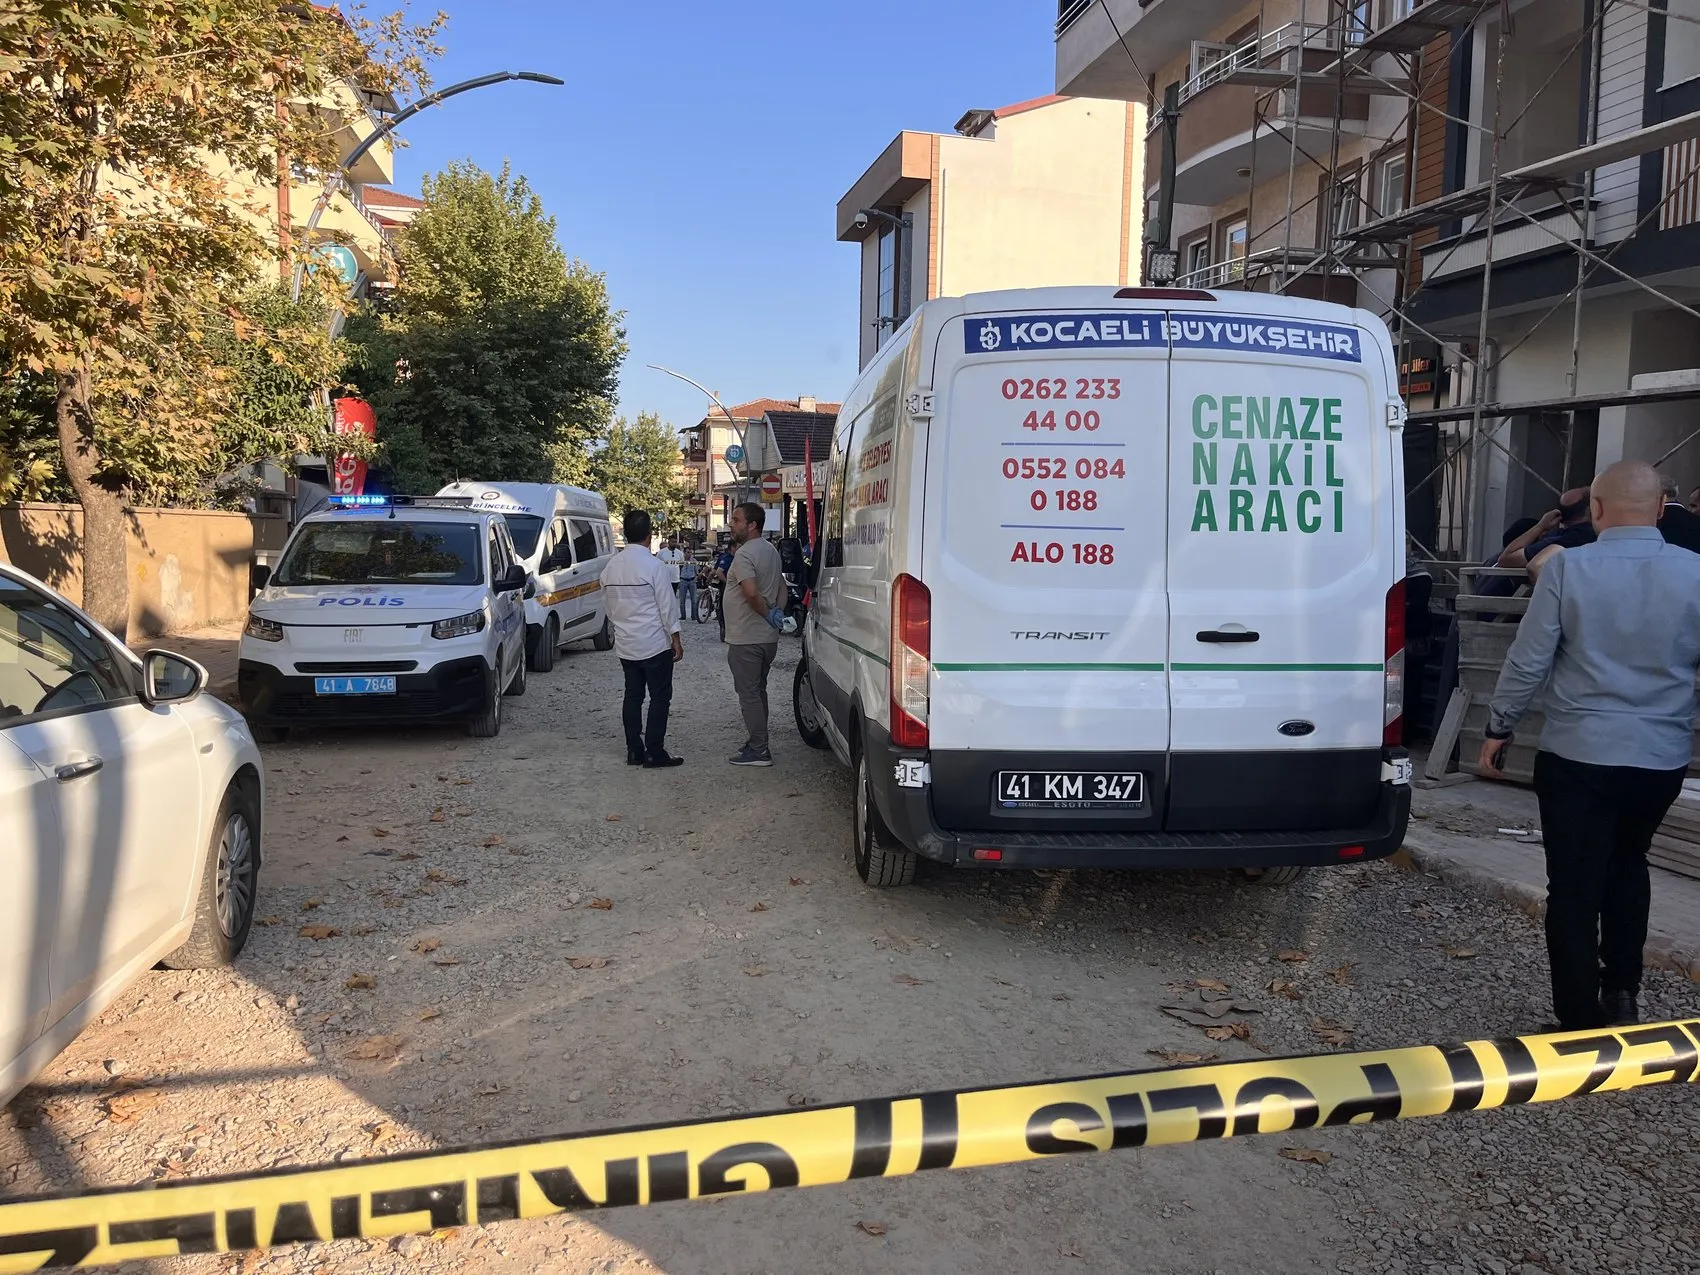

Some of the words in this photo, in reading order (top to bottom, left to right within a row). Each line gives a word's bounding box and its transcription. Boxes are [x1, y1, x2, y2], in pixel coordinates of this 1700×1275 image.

[1011, 320, 1150, 344] KOCAELİ
[1160, 320, 1354, 355] BÜYÜKŞEHİR
[1001, 378, 1067, 400] 0262
[1075, 378, 1121, 400] 233
[1022, 410, 1057, 431] 44
[1065, 410, 1100, 431] 00
[1191, 394, 1343, 441] CENAZE
[1002, 458, 1067, 479] 0552
[1075, 458, 1125, 479] 084
[1192, 442, 1344, 487] NAKİL
[1030, 489, 1047, 511] 0
[1055, 489, 1098, 511] 188
[1190, 489, 1343, 533] ARACI
[1010, 541, 1064, 563] ALO
[1072, 543, 1114, 565] 188
[318, 596, 405, 606] POLİS
[343, 628, 364, 643] FIAT
[1010, 631, 1111, 640] TRANSIT
[322, 679, 336, 692] 41
[345, 679, 354, 691] A
[364, 678, 395, 691] 7848
[1006, 774, 1030, 798] 41
[1044, 774, 1083, 799] KM
[1092, 775, 1137, 799] 347
